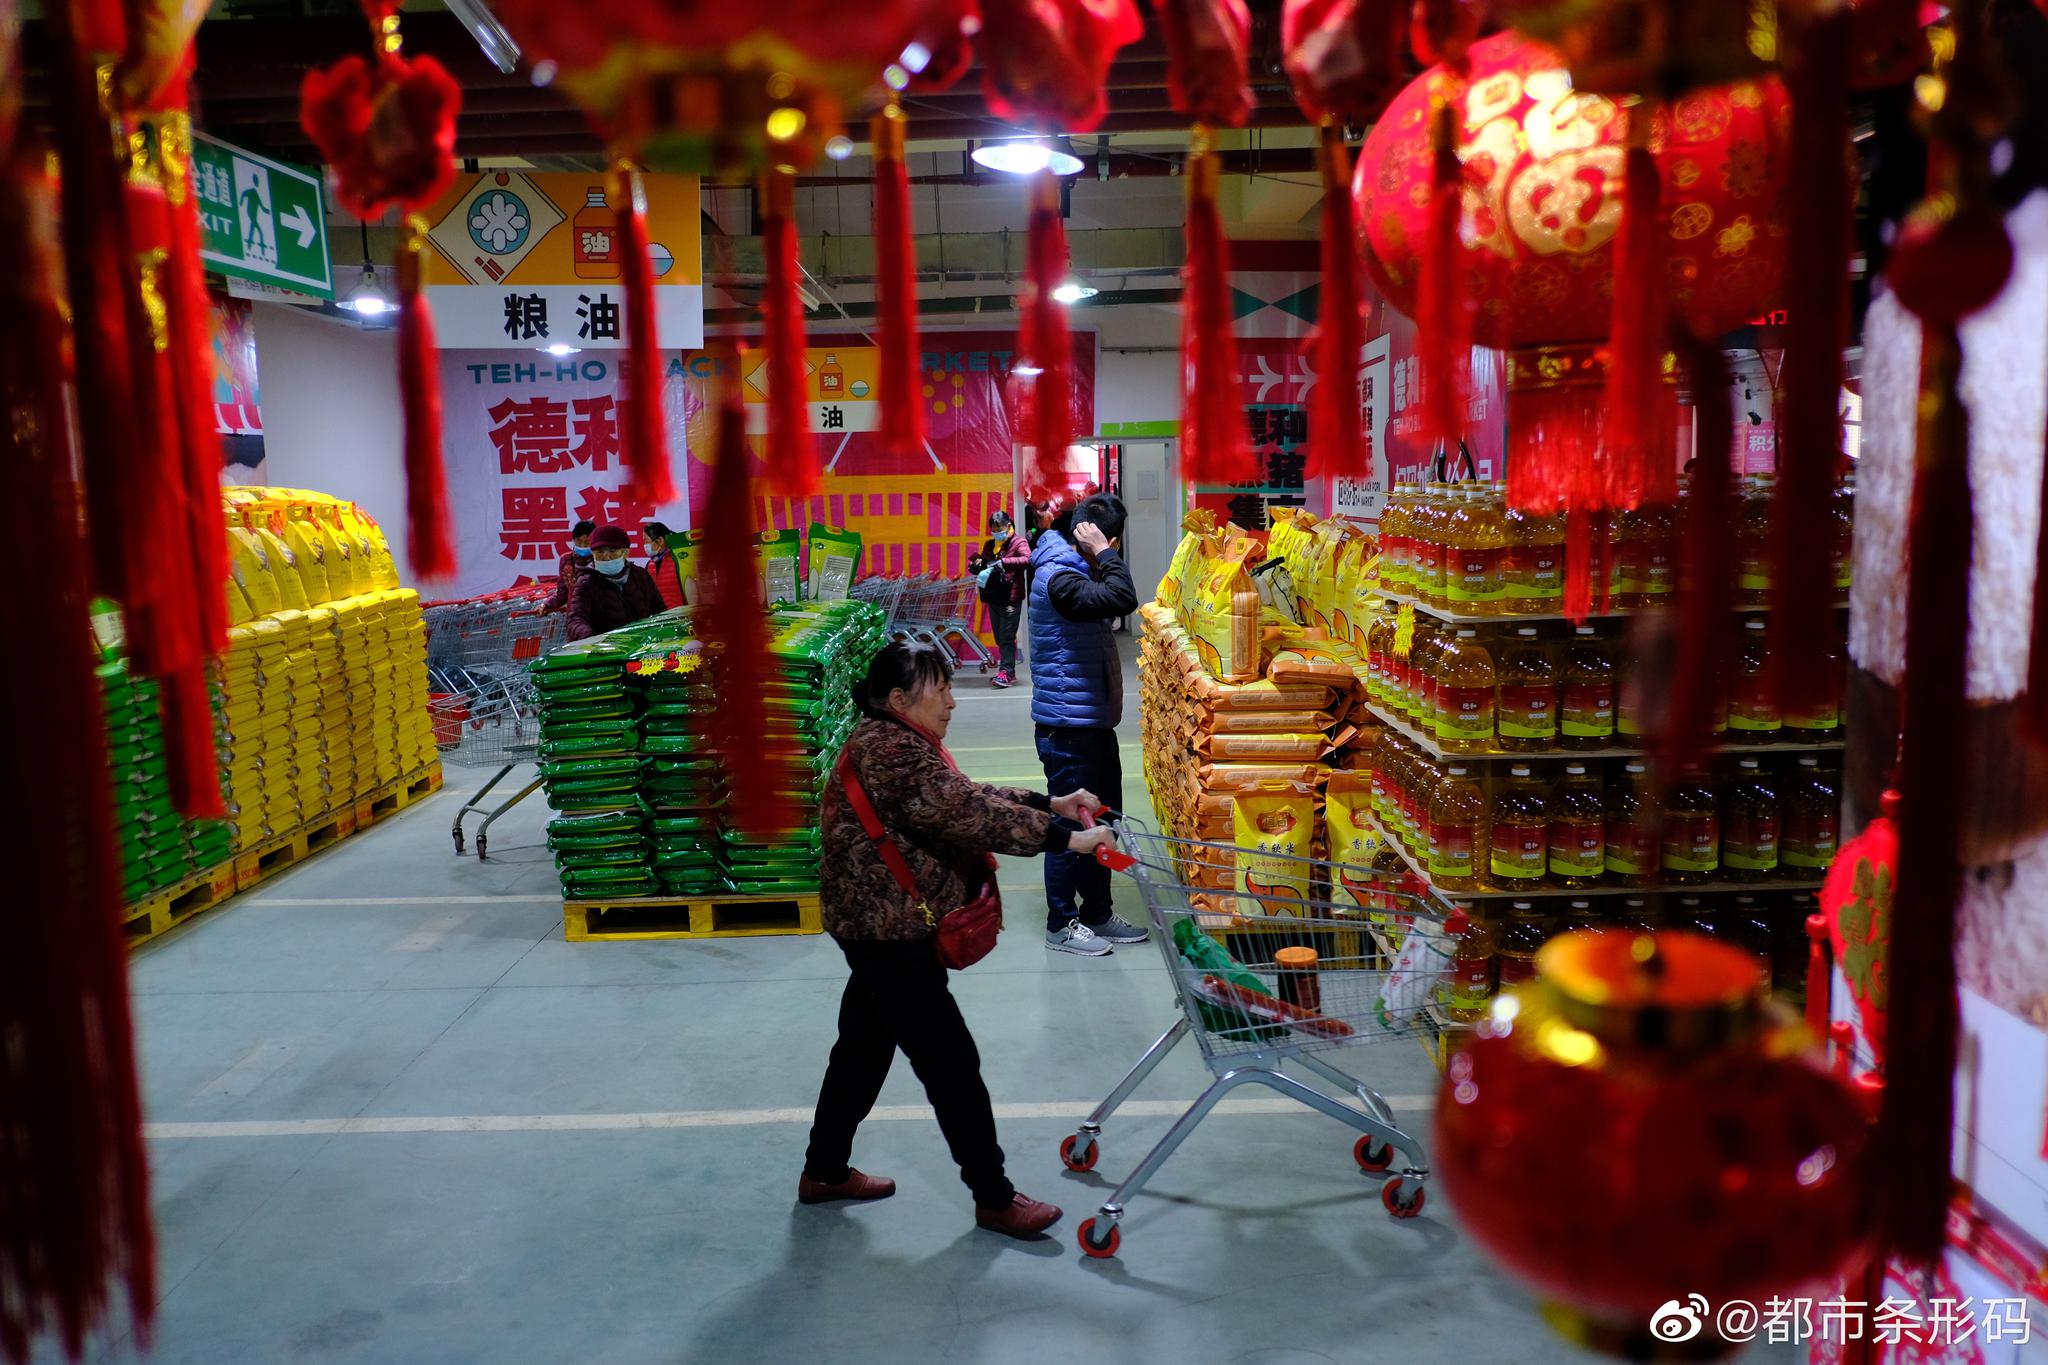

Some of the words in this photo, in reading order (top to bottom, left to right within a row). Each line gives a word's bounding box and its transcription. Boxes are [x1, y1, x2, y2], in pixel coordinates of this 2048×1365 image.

[195, 209, 233, 236] XIT
[581, 231, 611, 255] 油
[503, 293, 620, 340] 粮油
[466, 360, 607, 385] TEH-HO
[919, 350, 1014, 373] RKET
[488, 394, 642, 475] 德和
